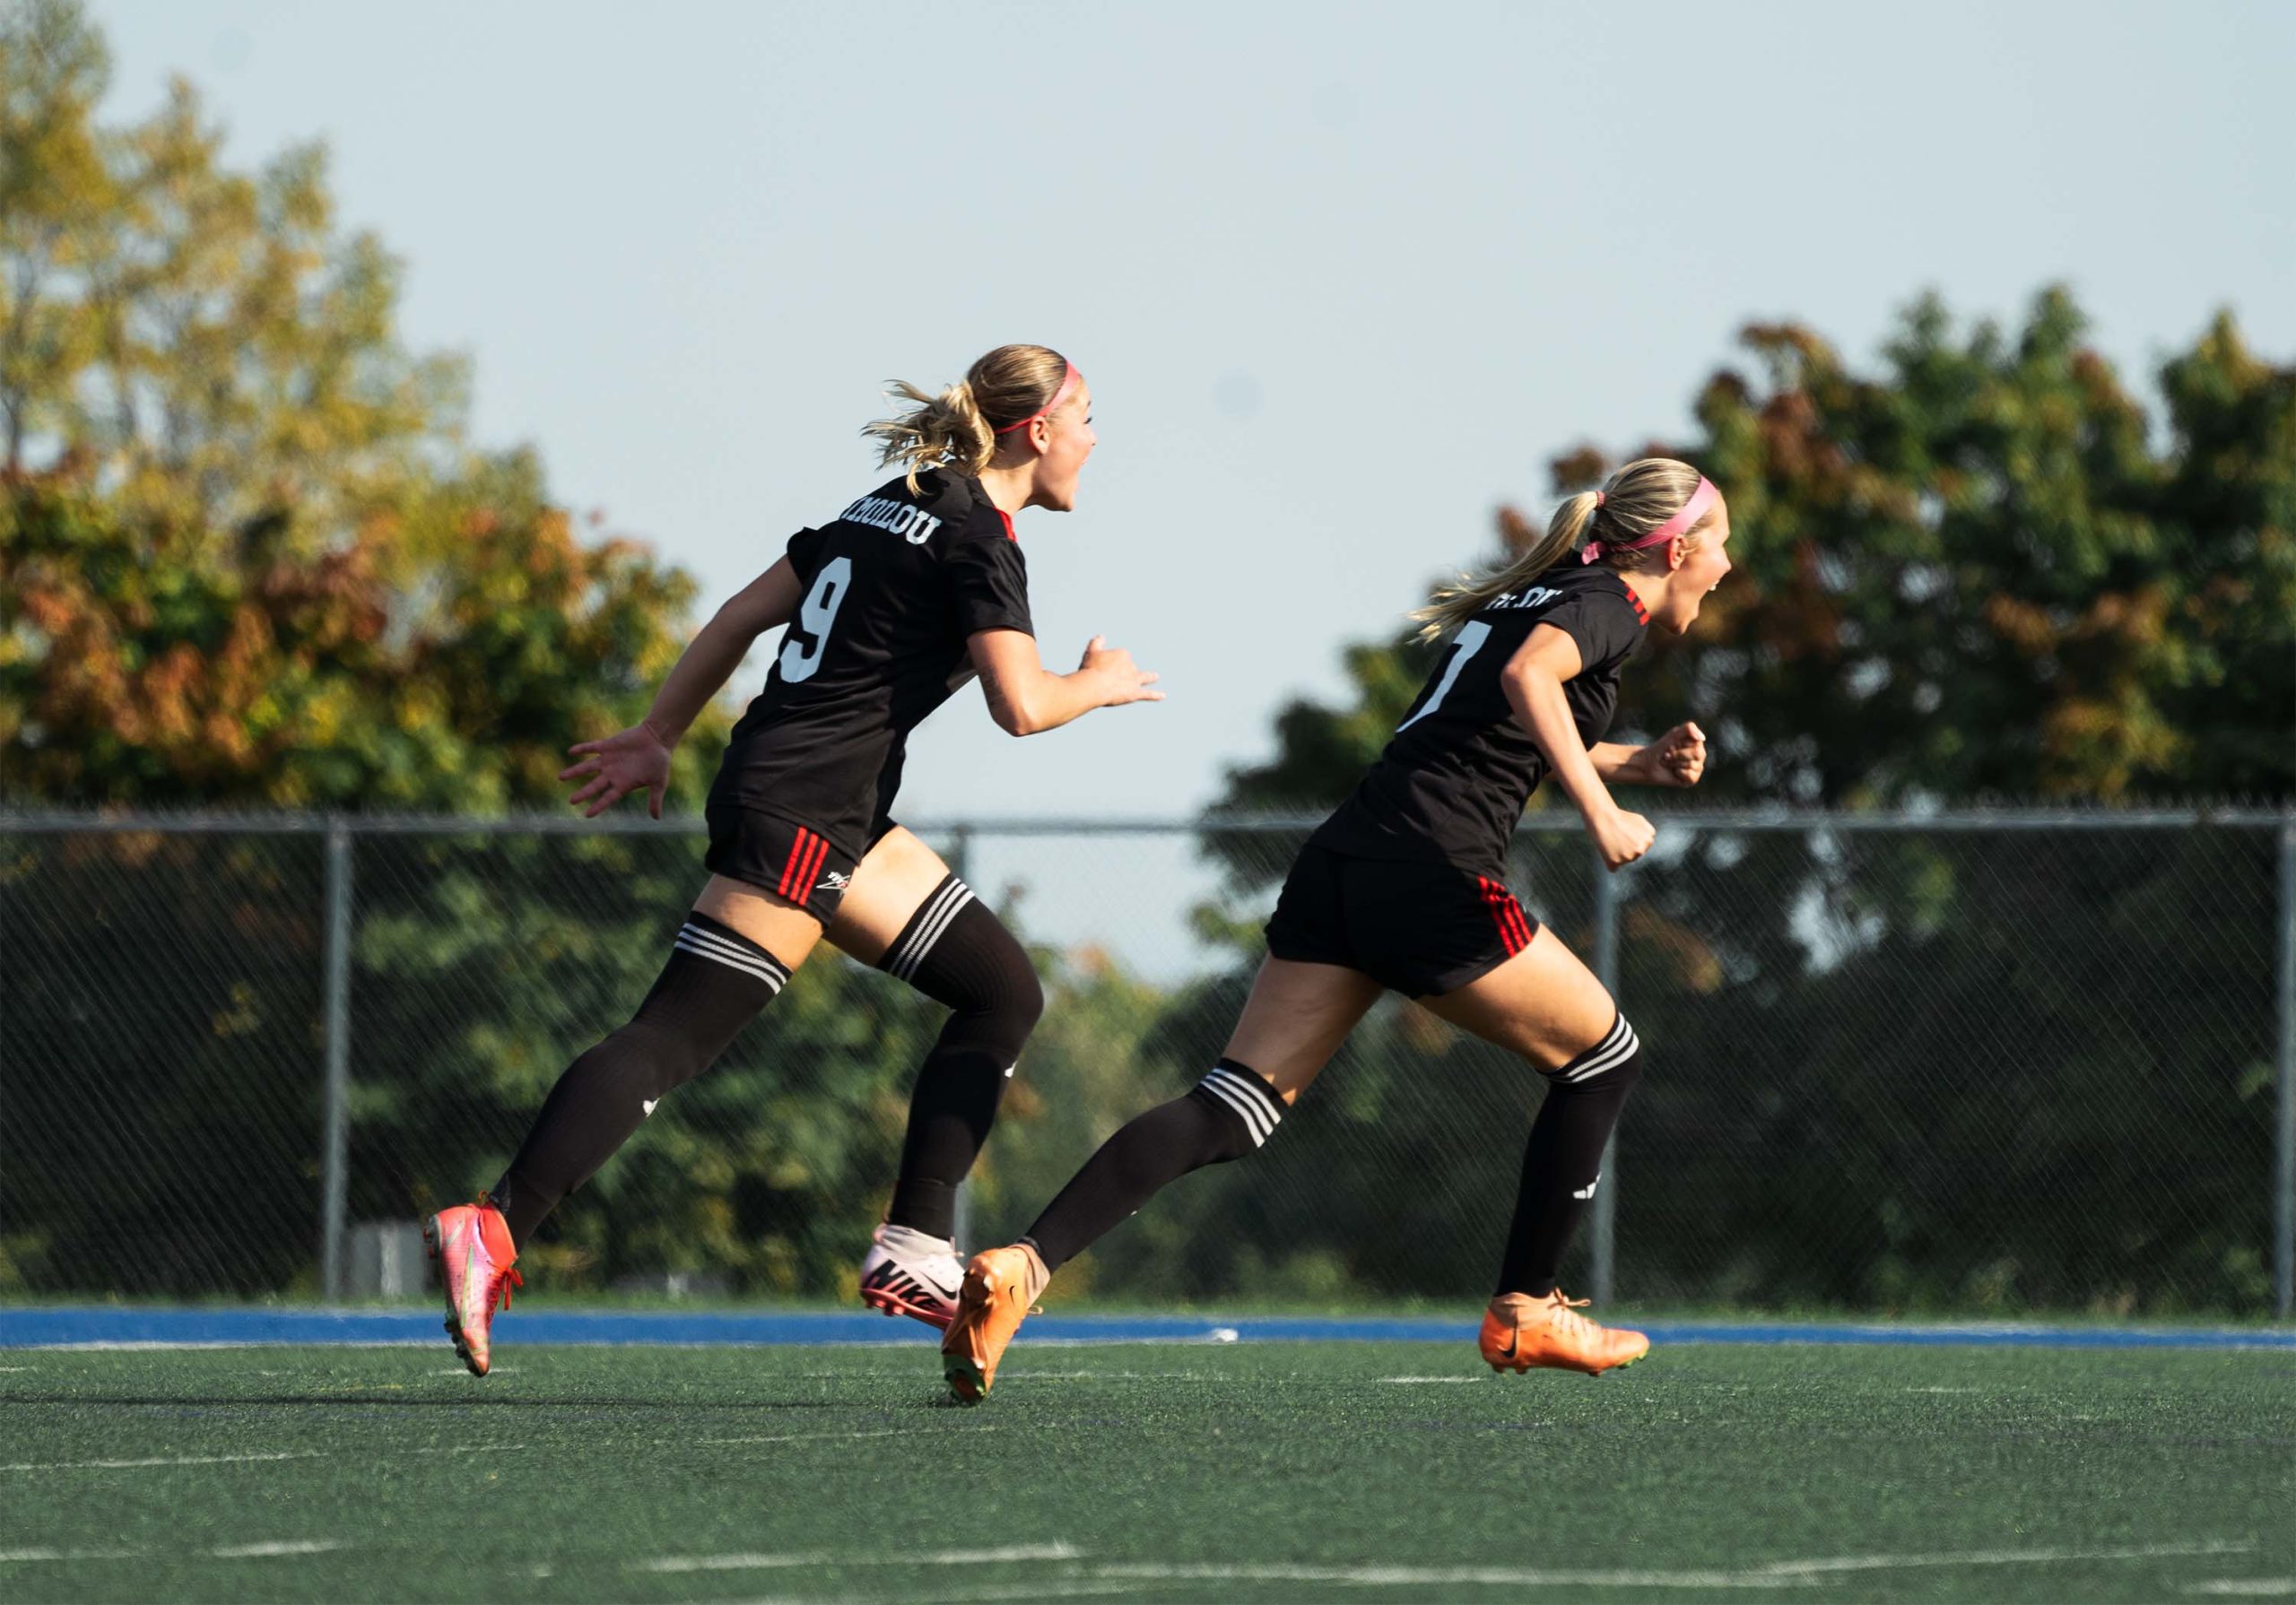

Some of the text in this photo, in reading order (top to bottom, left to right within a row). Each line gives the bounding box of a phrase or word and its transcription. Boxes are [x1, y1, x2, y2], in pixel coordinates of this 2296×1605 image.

[779, 556, 851, 683] 9
[1396, 620, 1492, 733] 7
[862, 1259, 947, 1309] NIKE
